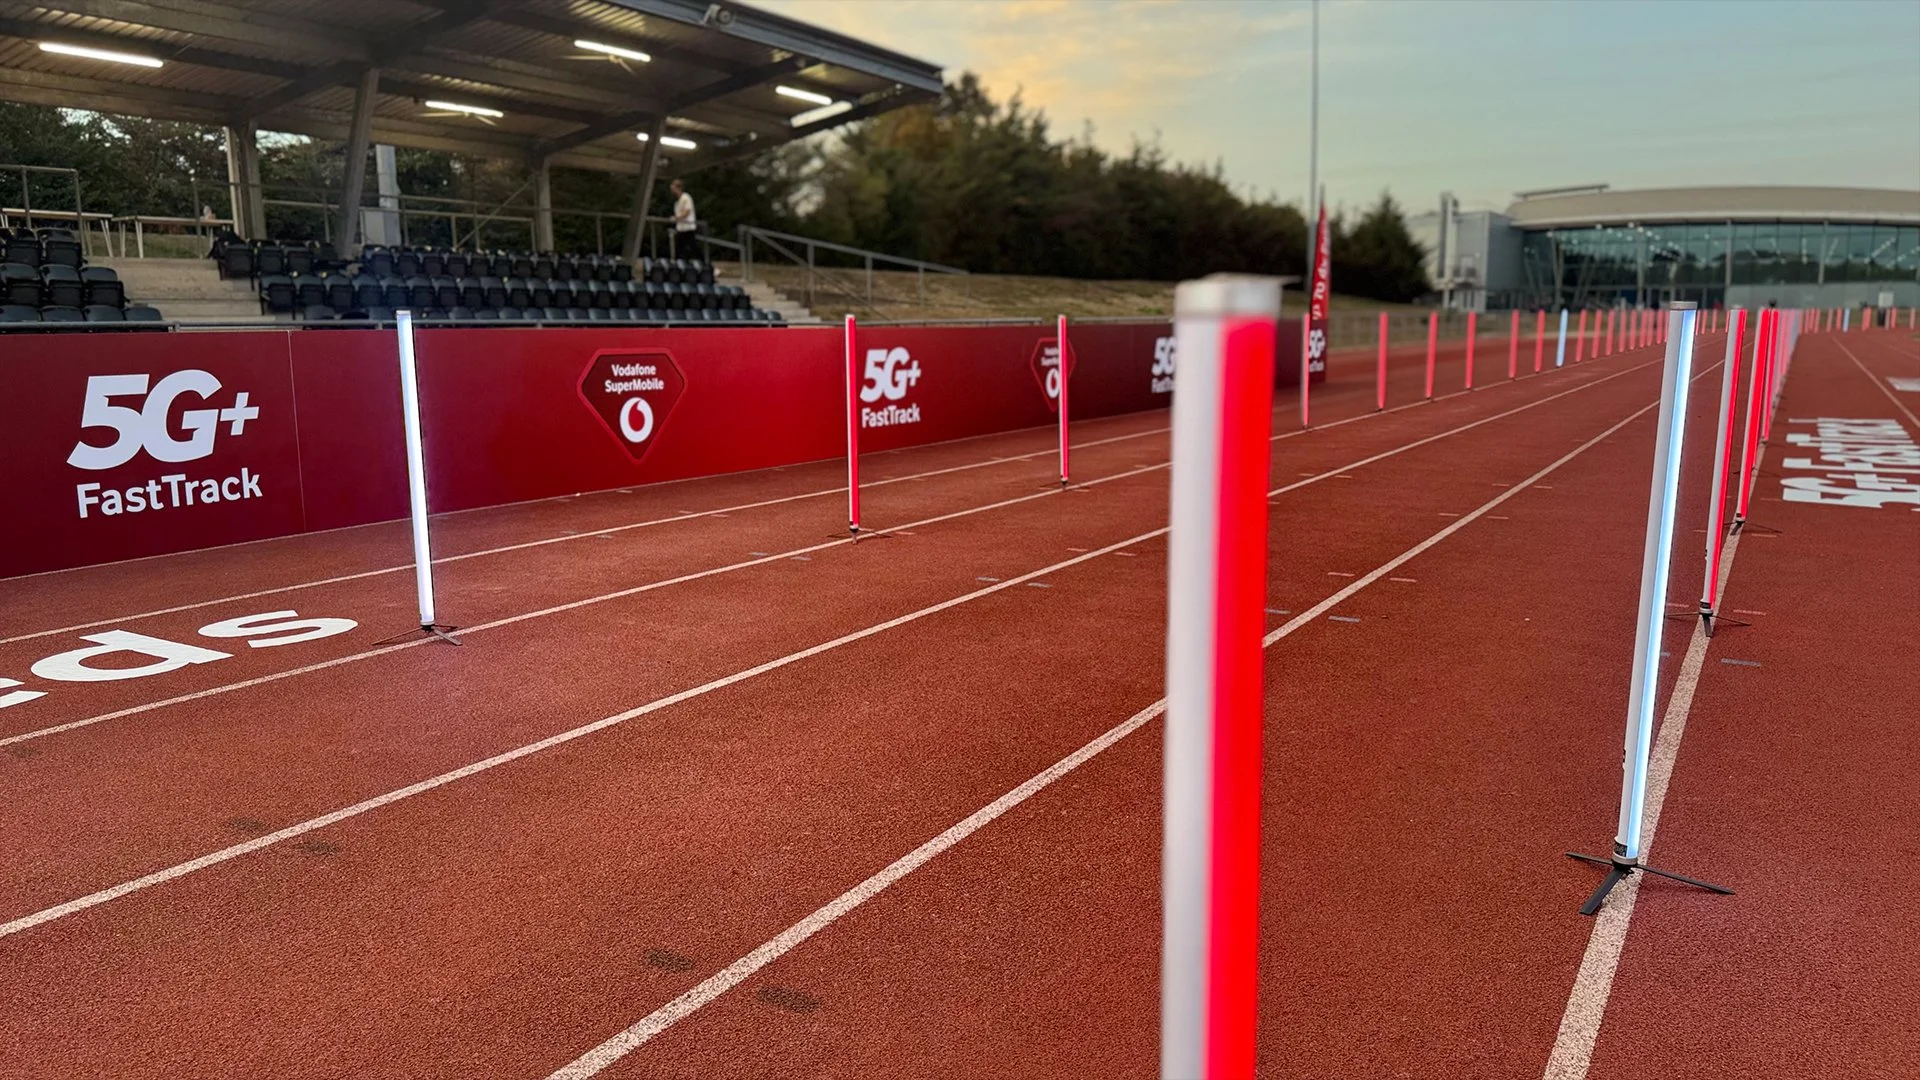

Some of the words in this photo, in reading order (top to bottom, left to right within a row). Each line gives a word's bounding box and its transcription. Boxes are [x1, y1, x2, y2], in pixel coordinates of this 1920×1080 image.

[604, 378, 665, 395] SuperMobile
[611, 363, 656, 377] Vodafone
[860, 346, 921, 403] 5G+
[67, 369, 260, 470] 5G+
[861, 402, 921, 428] FastTrack
[76, 467, 263, 519] FastTrack
